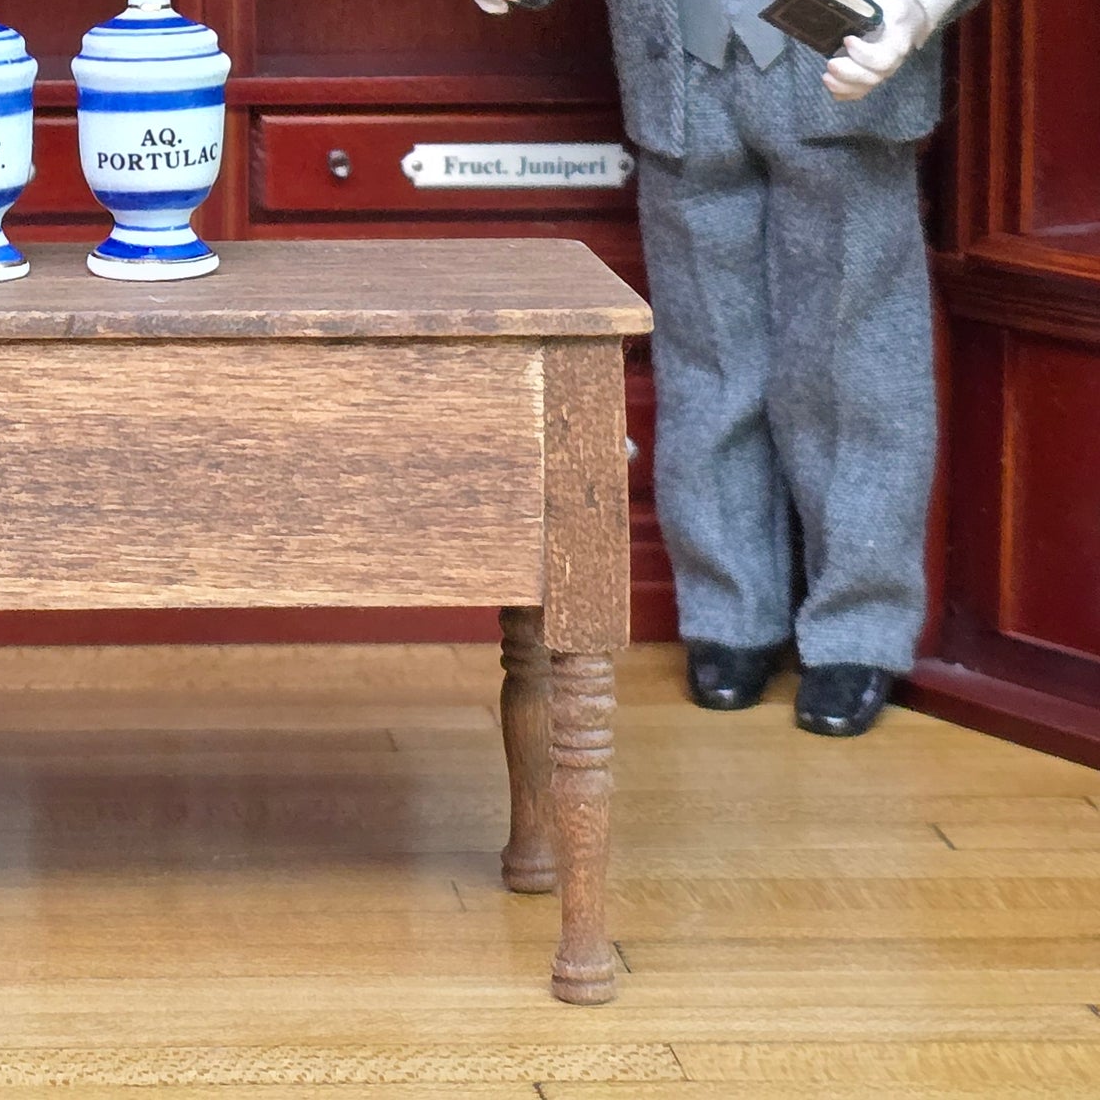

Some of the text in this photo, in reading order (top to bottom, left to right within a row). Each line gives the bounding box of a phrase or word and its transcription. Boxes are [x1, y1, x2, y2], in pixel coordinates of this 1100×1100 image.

[140, 127, 182, 148] AQ.
[97, 142, 218, 171] PORTULAC
[443, 155, 606, 179] Fruct. Juniperi
